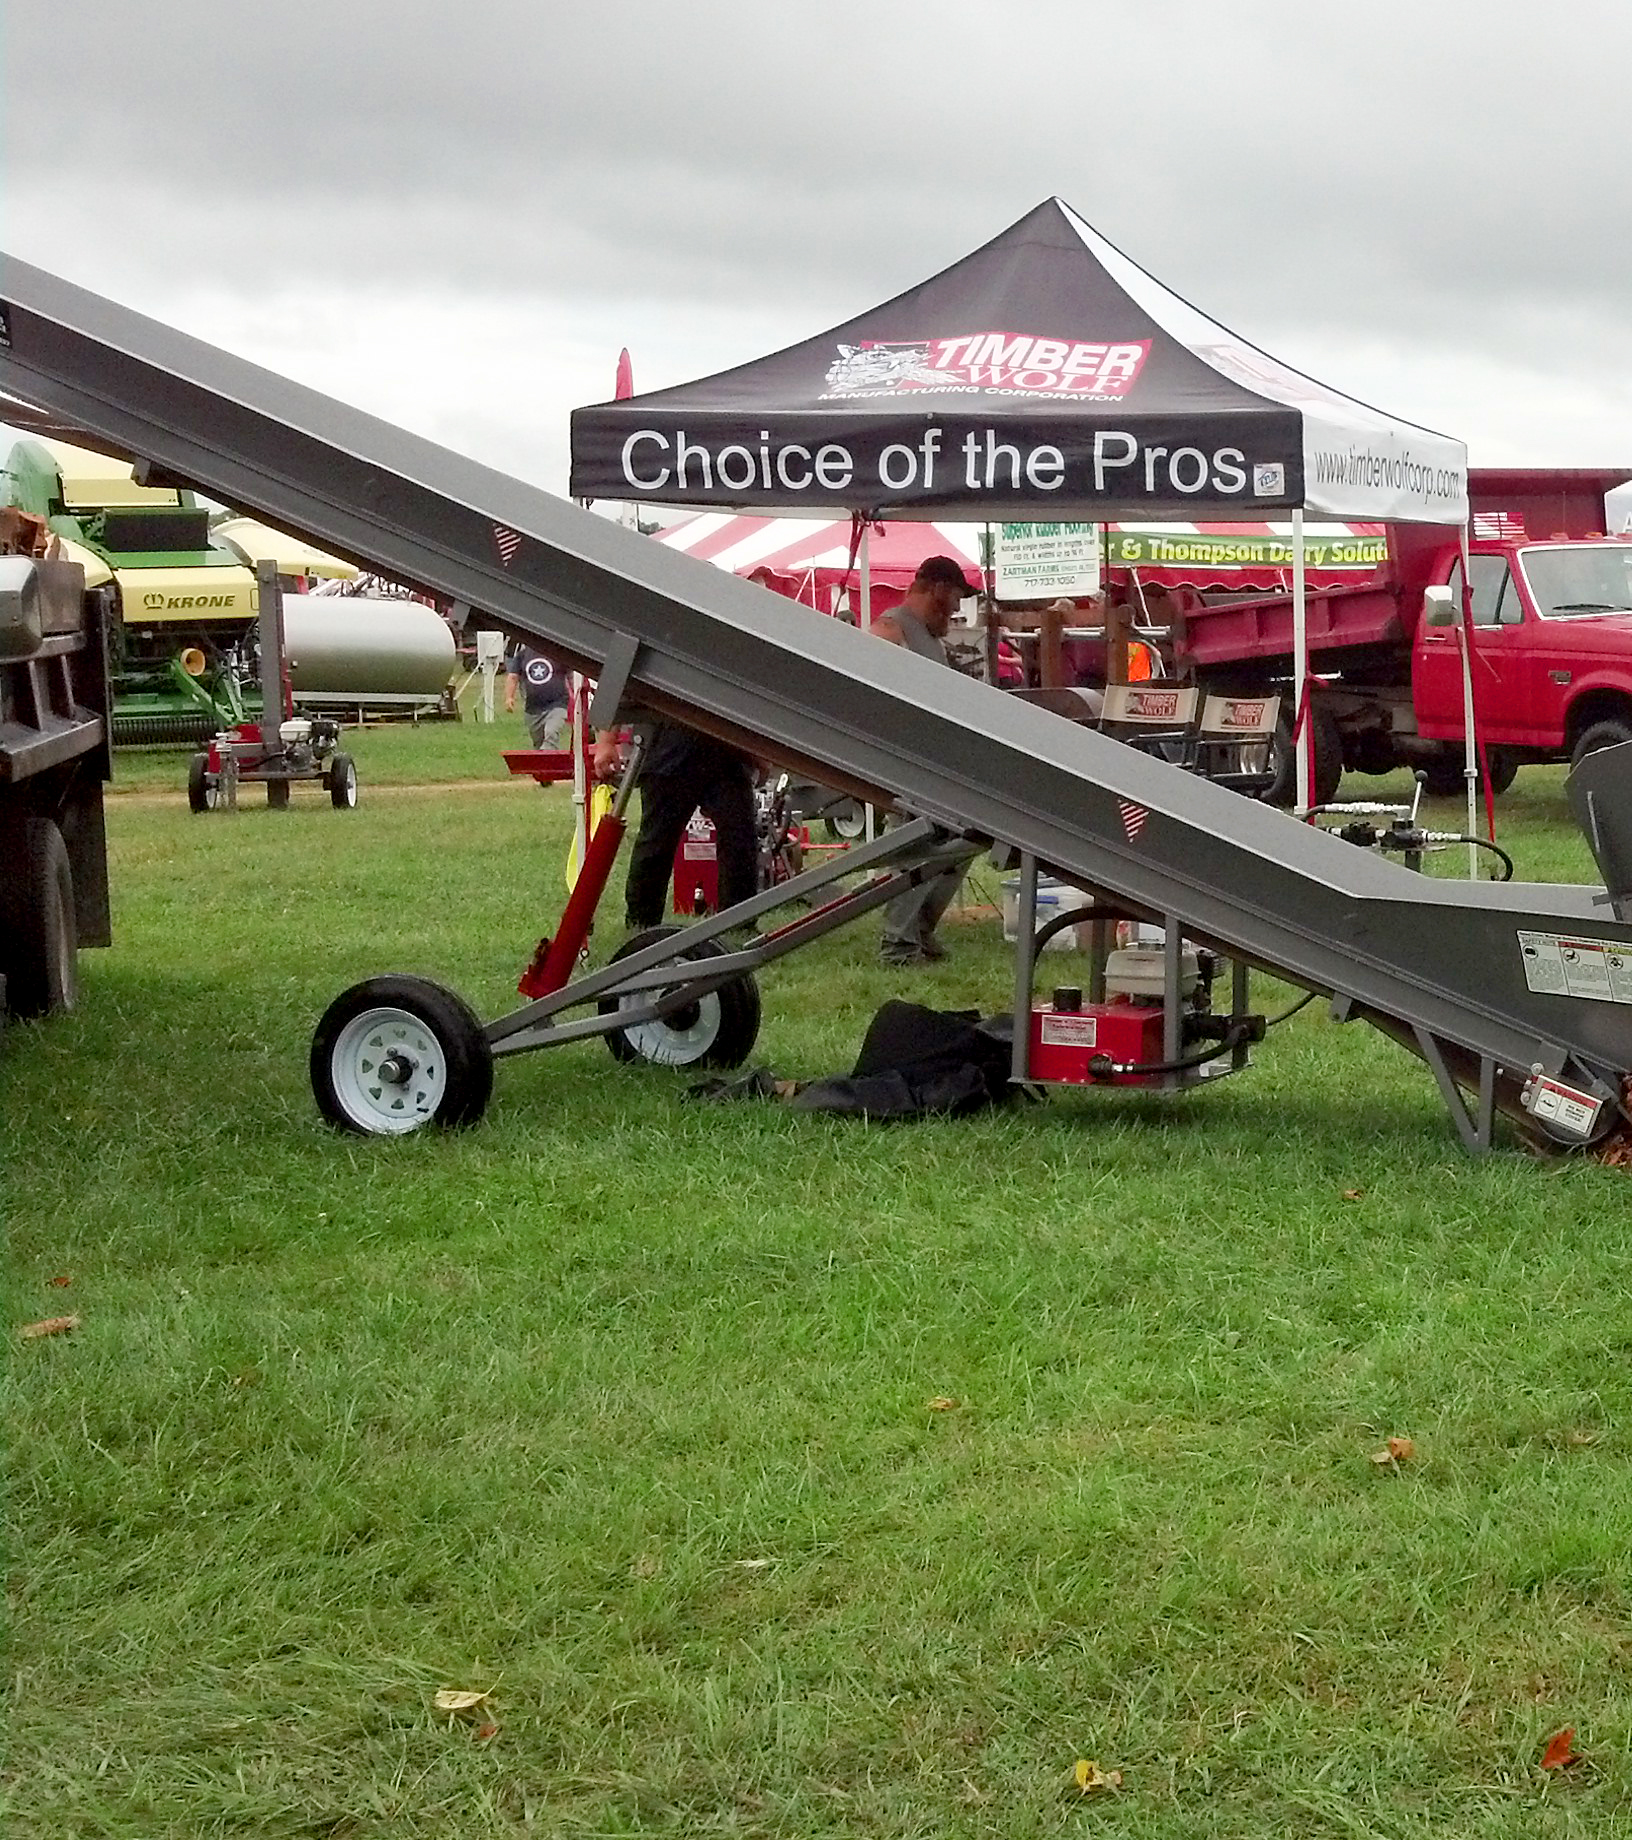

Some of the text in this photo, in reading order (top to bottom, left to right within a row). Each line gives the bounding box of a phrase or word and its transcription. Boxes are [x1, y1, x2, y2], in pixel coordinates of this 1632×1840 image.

[936, 334, 1144, 376] TIMBER
[965, 365, 1130, 392] WOLF
[818, 384, 1124, 402] MANUFACTURING CORPORATION
[621, 428, 1247, 493] Choice of the Pros
[1313, 444, 1460, 504] www.timberwolfcorp.com
[1121, 538, 1142, 560] &
[1148, 539, 1263, 565] Thompson
[1269, 542, 1327, 566] Dary
[167, 595, 235, 609] KRONE
[1142, 694, 1177, 707] TIMBER
[1143, 705, 1175, 716] WOLF
